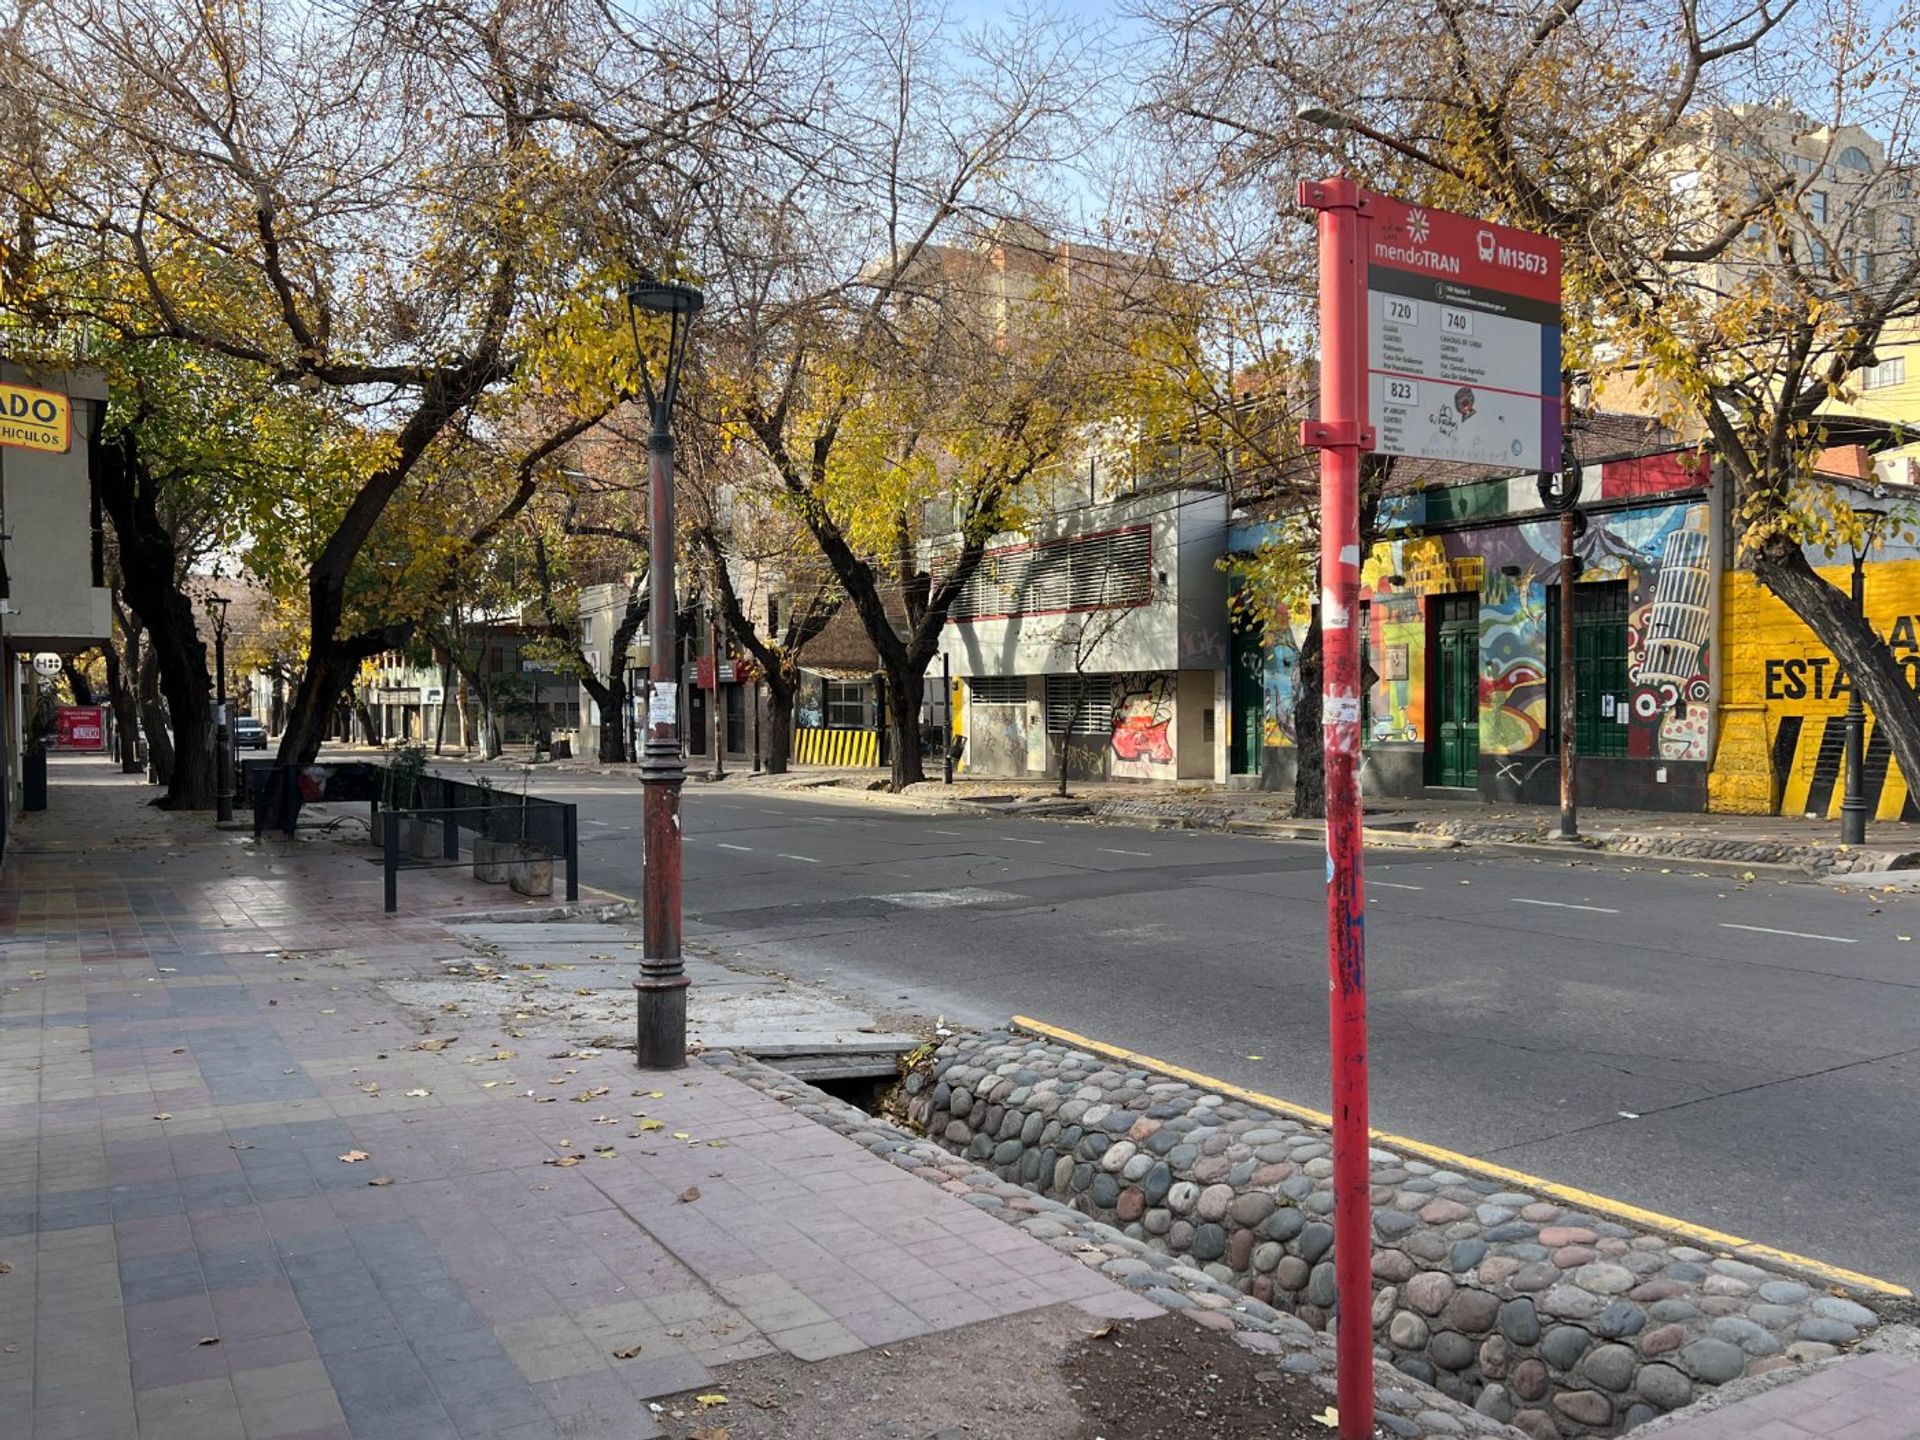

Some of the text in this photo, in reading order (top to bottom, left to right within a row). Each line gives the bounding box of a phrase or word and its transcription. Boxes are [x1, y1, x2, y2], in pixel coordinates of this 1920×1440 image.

[1375, 243, 1460, 274] mendoTRAN
[1498, 246, 1548, 275] M15673
[1390, 301, 1411, 319] 720
[1447, 312, 1466, 330] 740
[1391, 382, 1411, 399] 823
